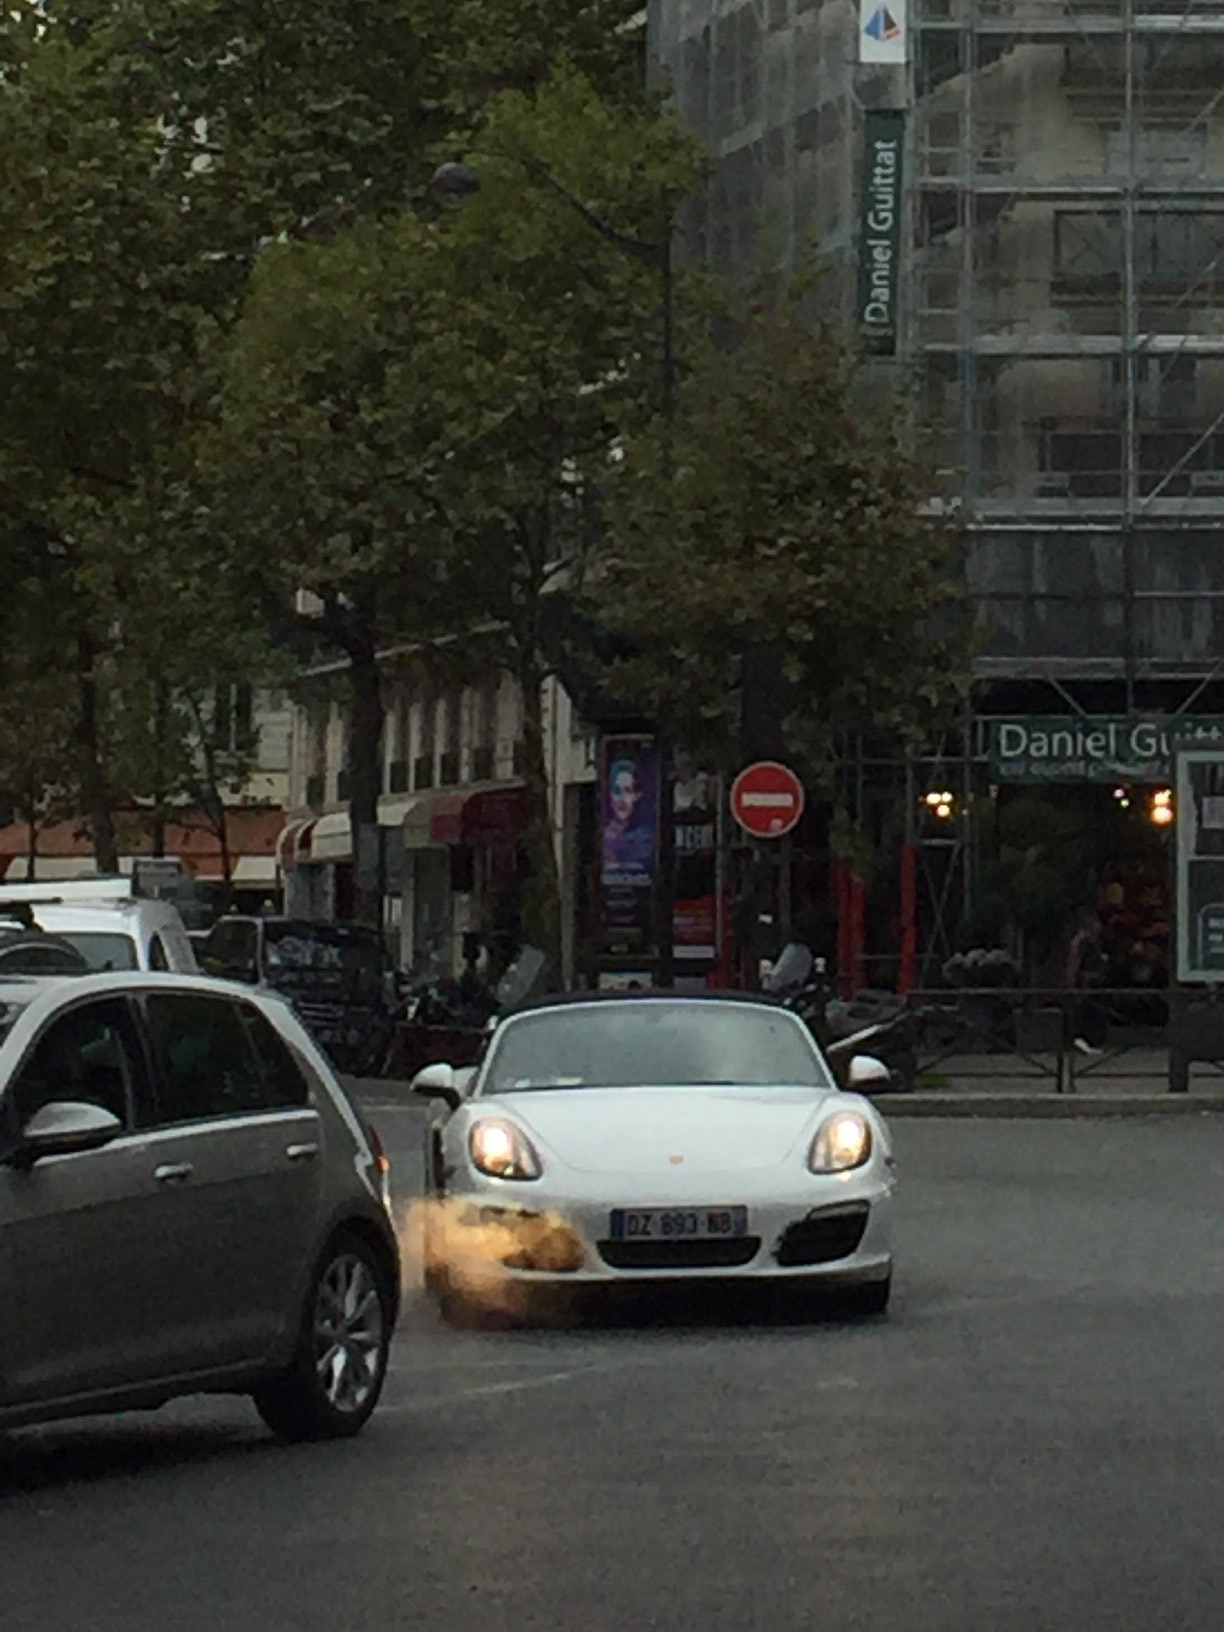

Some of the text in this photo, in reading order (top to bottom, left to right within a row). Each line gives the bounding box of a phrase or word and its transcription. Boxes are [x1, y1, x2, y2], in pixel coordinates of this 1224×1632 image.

[868, 139, 897, 232] Guittat
[864, 239, 892, 323] Daniel
[1000, 723, 1117, 758] Daniel
